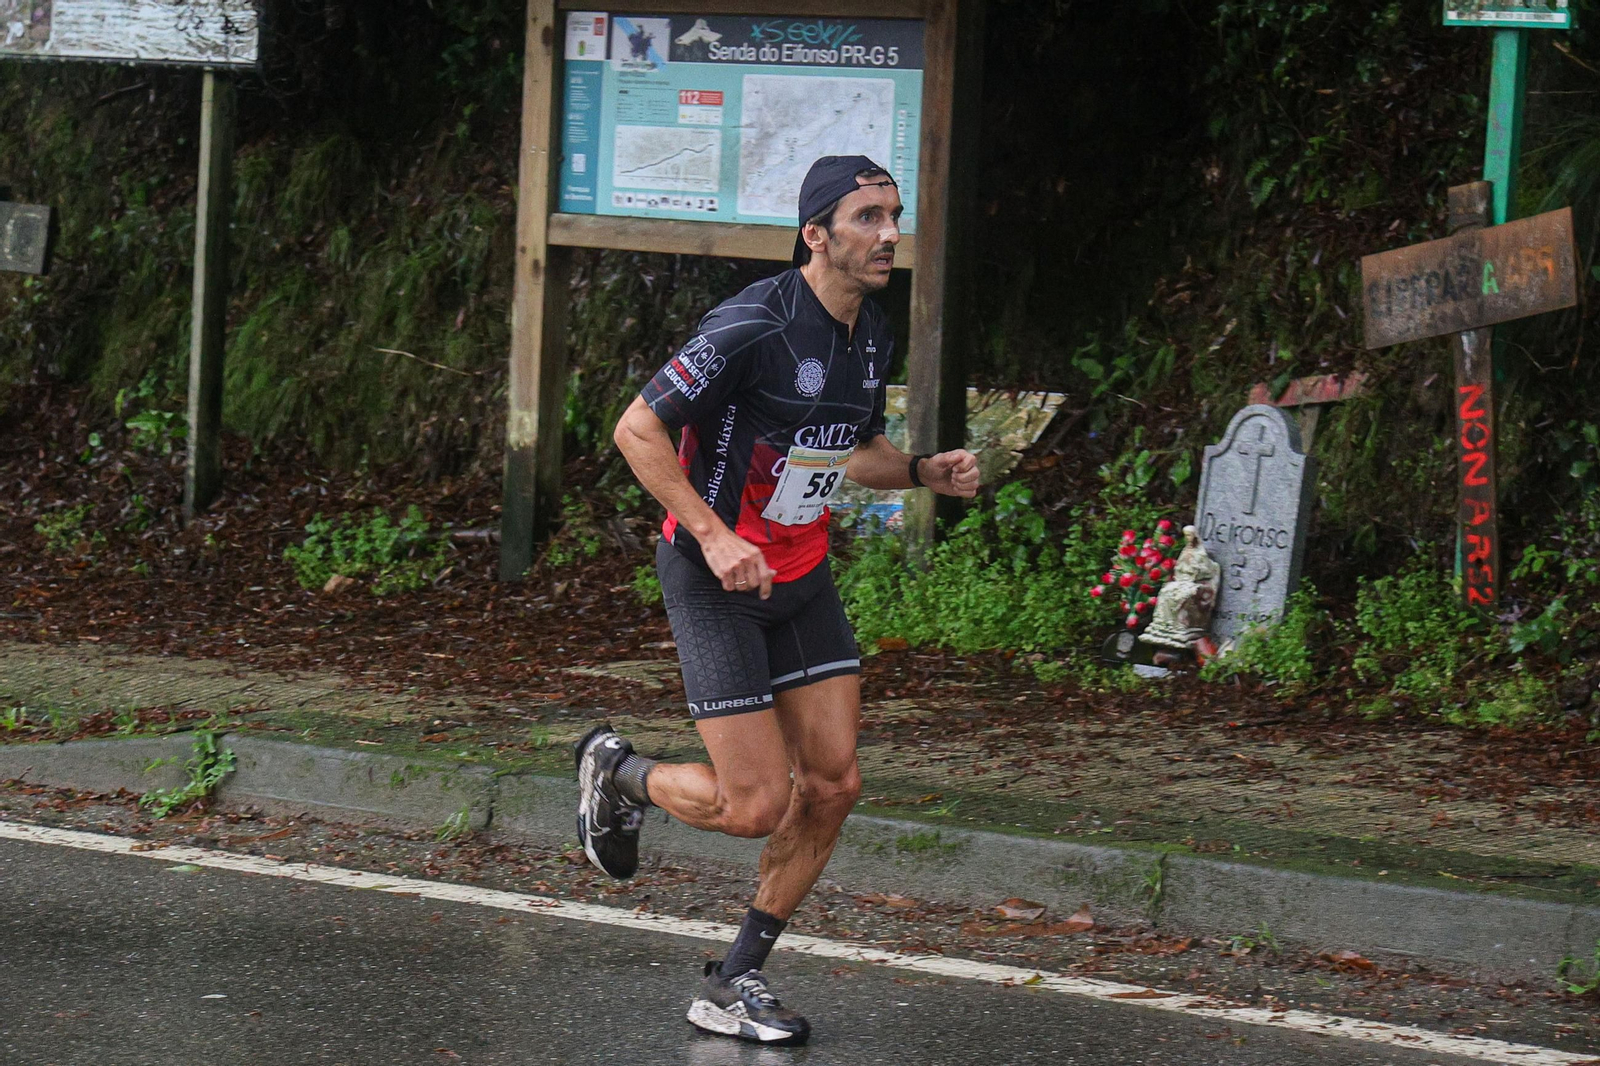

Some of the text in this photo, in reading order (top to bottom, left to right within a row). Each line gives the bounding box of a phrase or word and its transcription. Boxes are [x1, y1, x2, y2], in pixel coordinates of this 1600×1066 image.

[708, 41, 757, 61] Senda
[759, 43, 779, 62] do
[840, 45, 886, 65] PR-G
[887, 46, 900, 66] 5
[679, 91, 700, 104] 112
[678, 352, 710, 388] CAMISETAS
[685, 334, 727, 380] 700
[663, 364, 697, 402] LEUCEMIA
[691, 381, 703, 396] LA
[1458, 385, 1491, 487] NON
[702, 404, 737, 509] Galicia Máxica
[802, 471, 839, 499] 58
[703, 695, 764, 712] LURBEL
